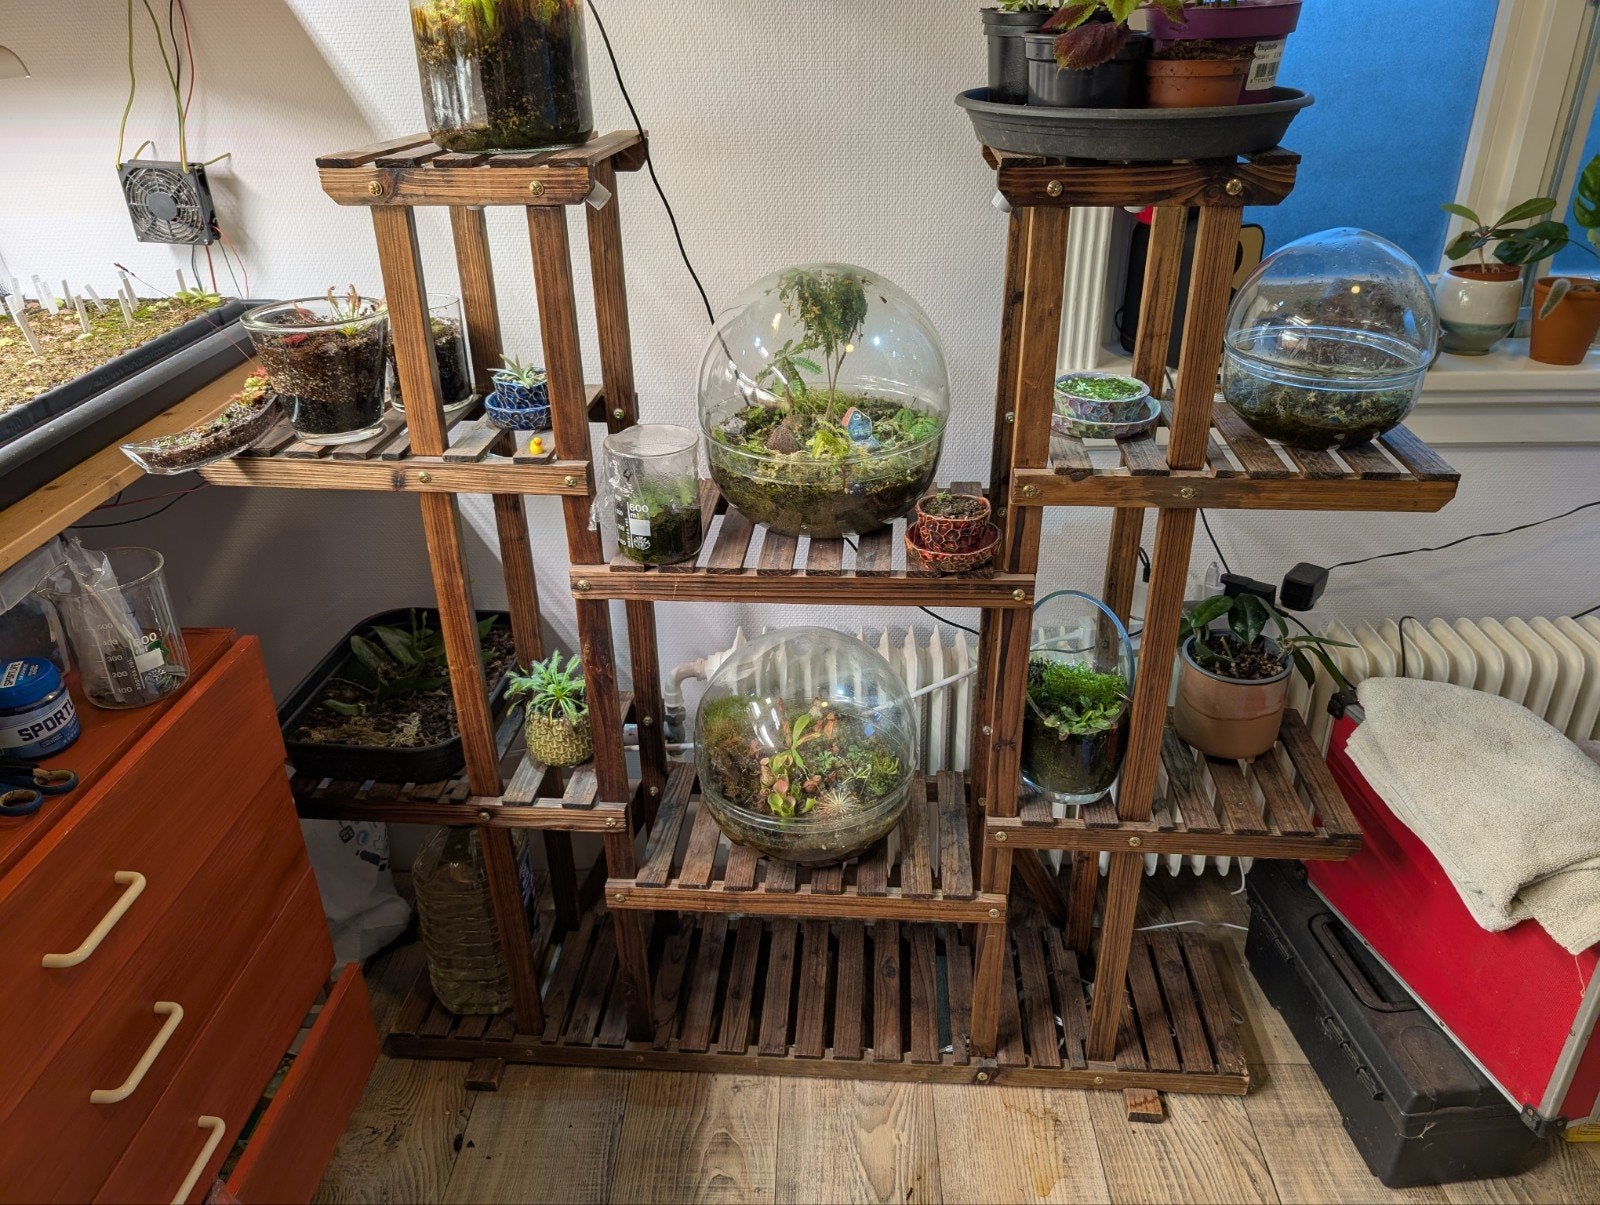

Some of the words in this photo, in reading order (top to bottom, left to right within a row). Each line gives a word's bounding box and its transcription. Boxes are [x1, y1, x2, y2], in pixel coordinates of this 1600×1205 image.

[629, 503, 649, 513] 600
[111, 670, 128, 678] 200
[118, 686, 133, 694] 100
